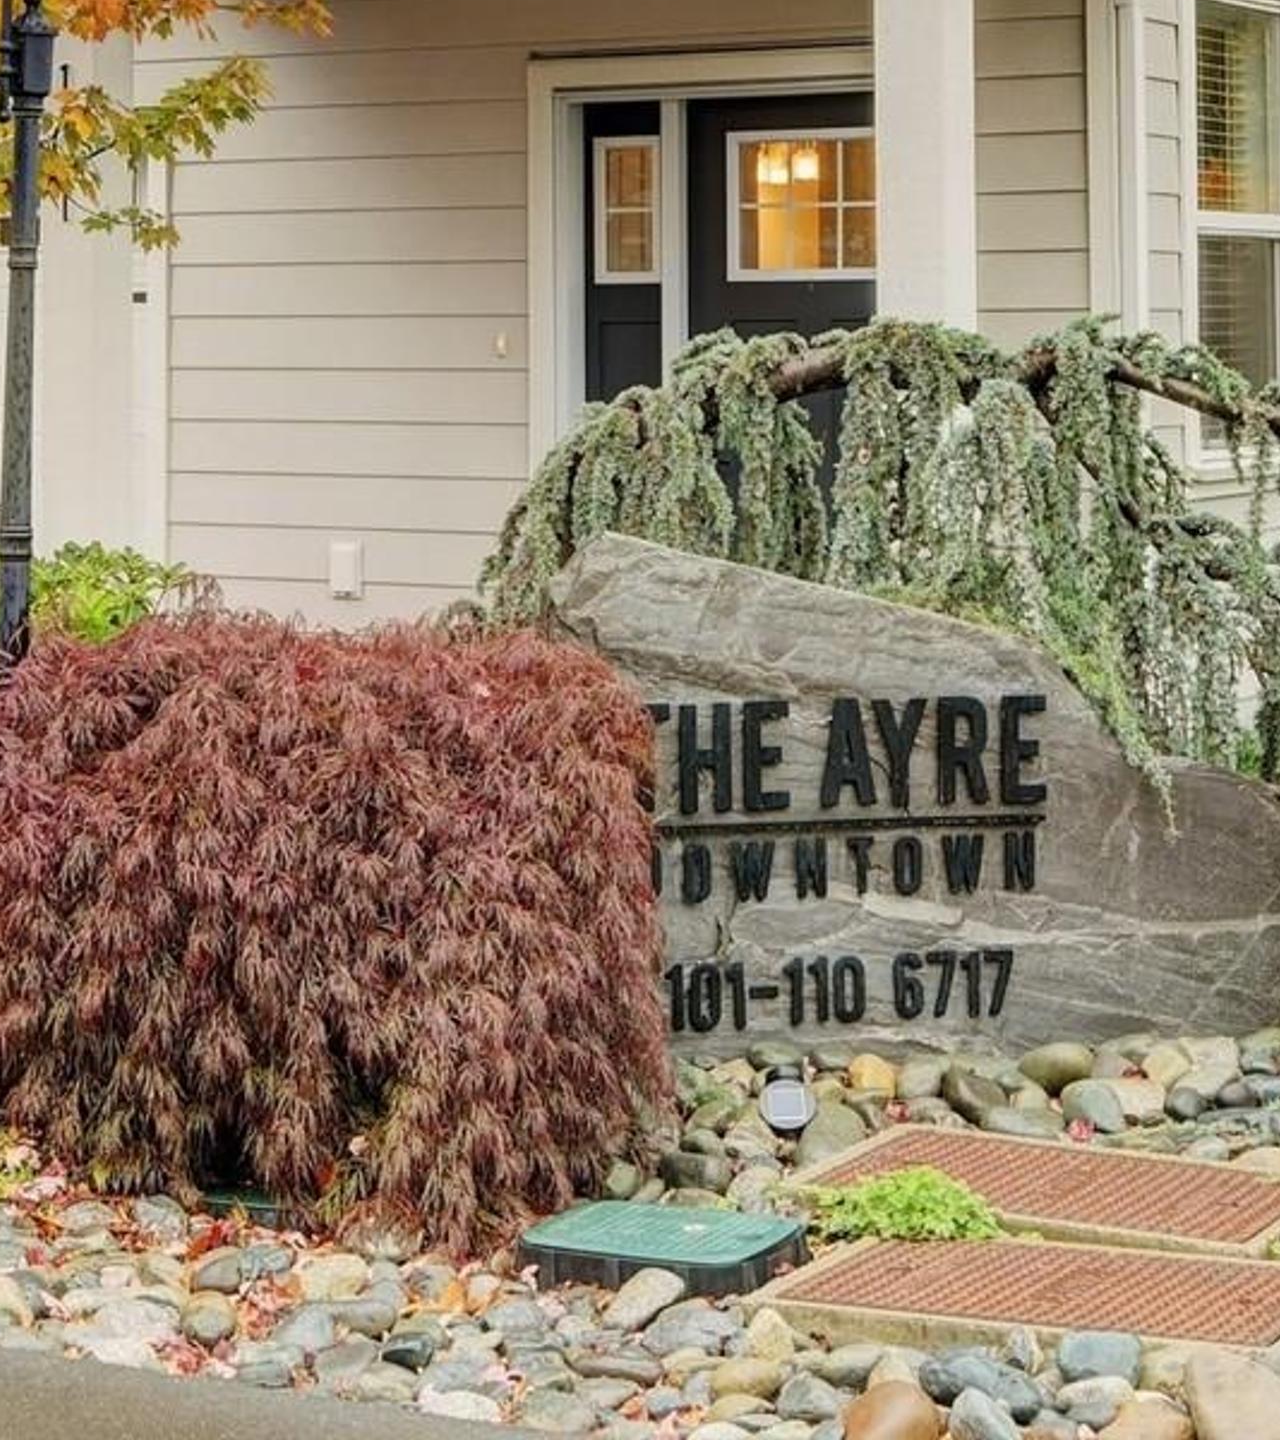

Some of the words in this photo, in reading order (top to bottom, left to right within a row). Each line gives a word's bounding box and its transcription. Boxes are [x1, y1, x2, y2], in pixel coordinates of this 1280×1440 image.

[819, 694, 1047, 809] AYRE
[664, 954, 865, 1031] 101-110
[892, 949, 1013, 1019] 6717
